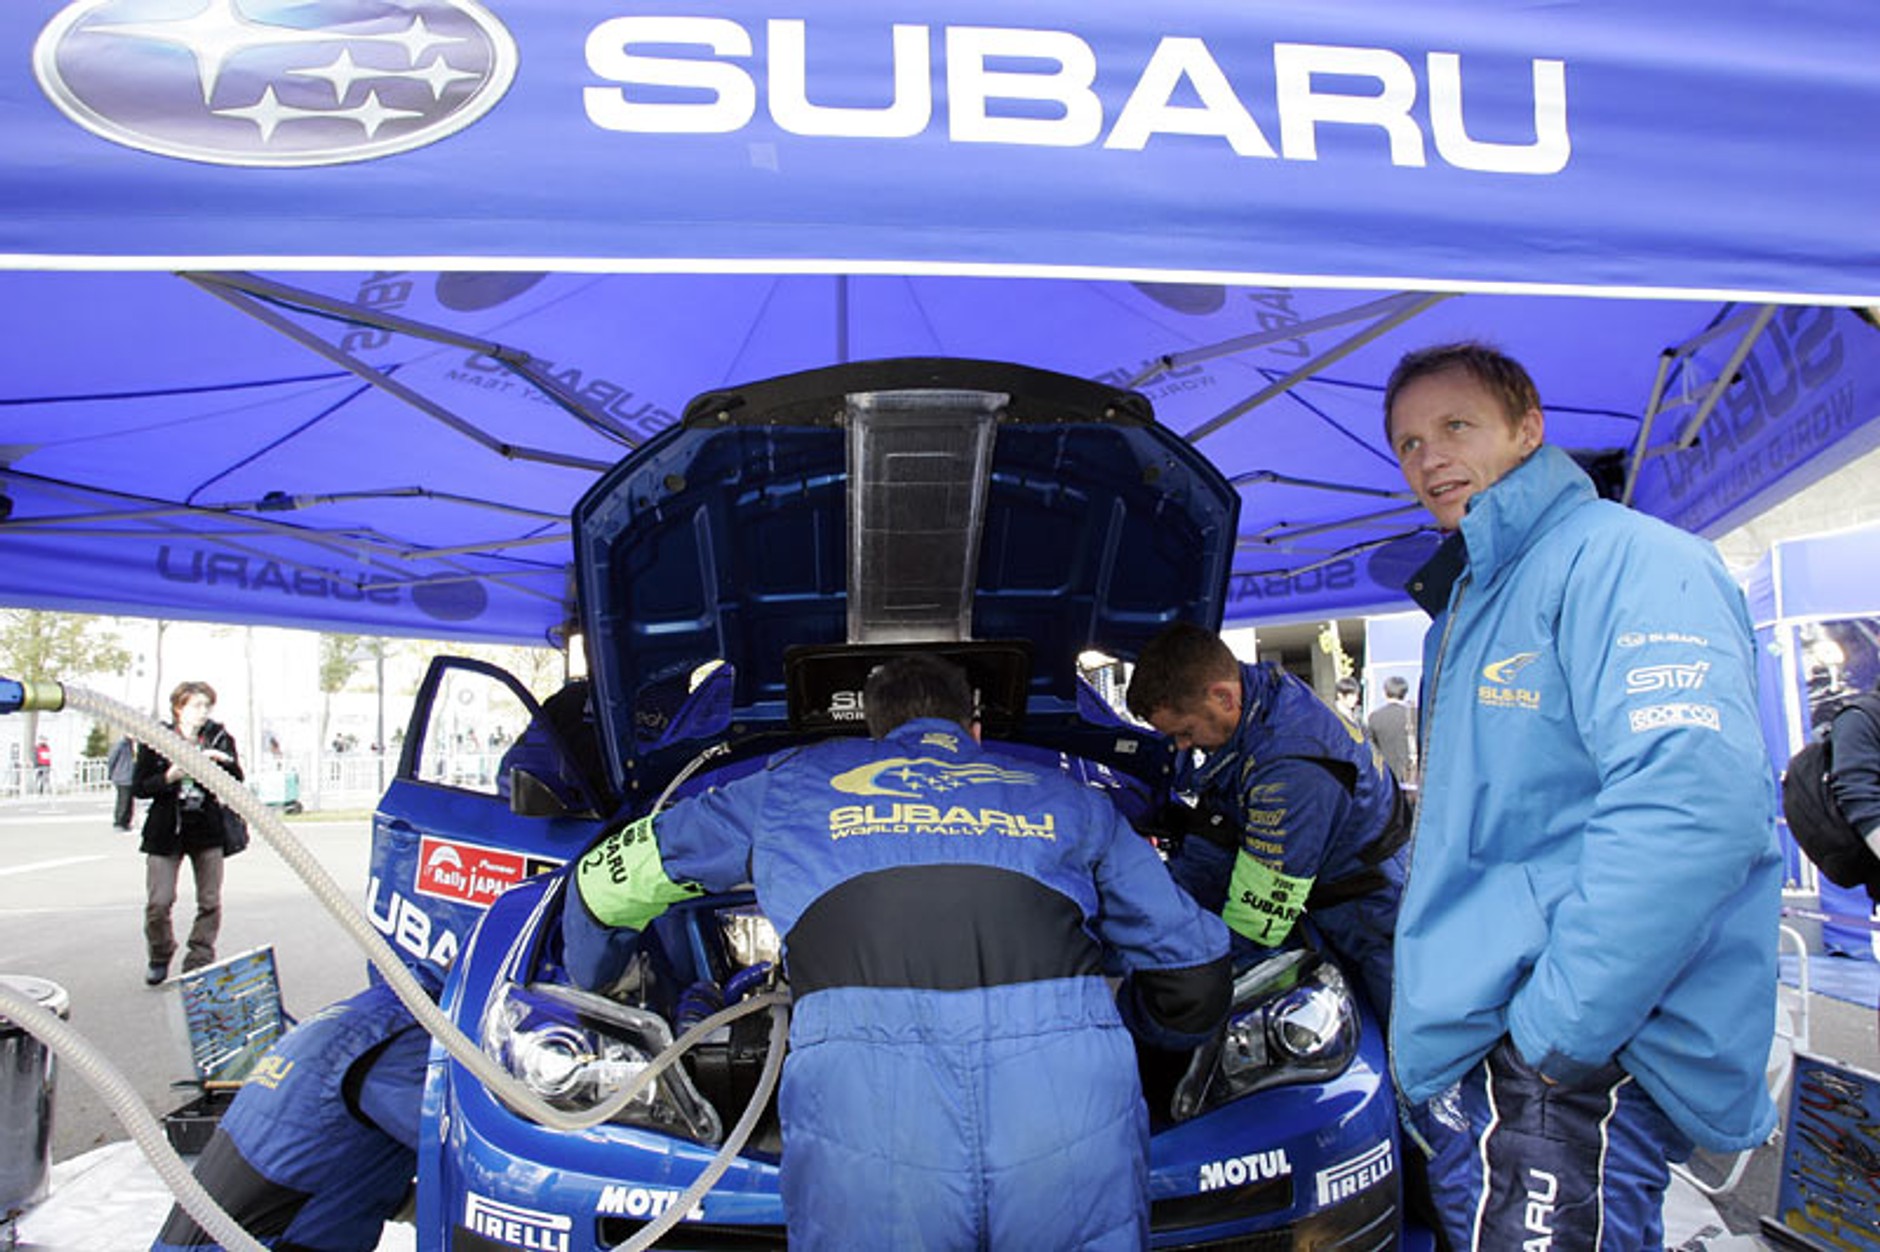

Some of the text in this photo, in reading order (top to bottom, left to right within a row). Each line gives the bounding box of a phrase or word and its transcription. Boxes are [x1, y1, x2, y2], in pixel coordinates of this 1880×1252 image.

[583, 15, 1571, 175] SUBARU
[829, 803, 1055, 831] SUBARU
[831, 823, 909, 840] WORLD
[916, 823, 987, 836] RALLY
[433, 868, 468, 891] Rally
[582, 851, 604, 875] 2
[366, 876, 459, 967] UBA
[1259, 918, 1273, 940] 1
[1200, 1148, 1292, 1192] MOTUL
[1316, 1138, 1393, 1206] PIRELLI
[465, 1191, 572, 1252] PIRELLI
